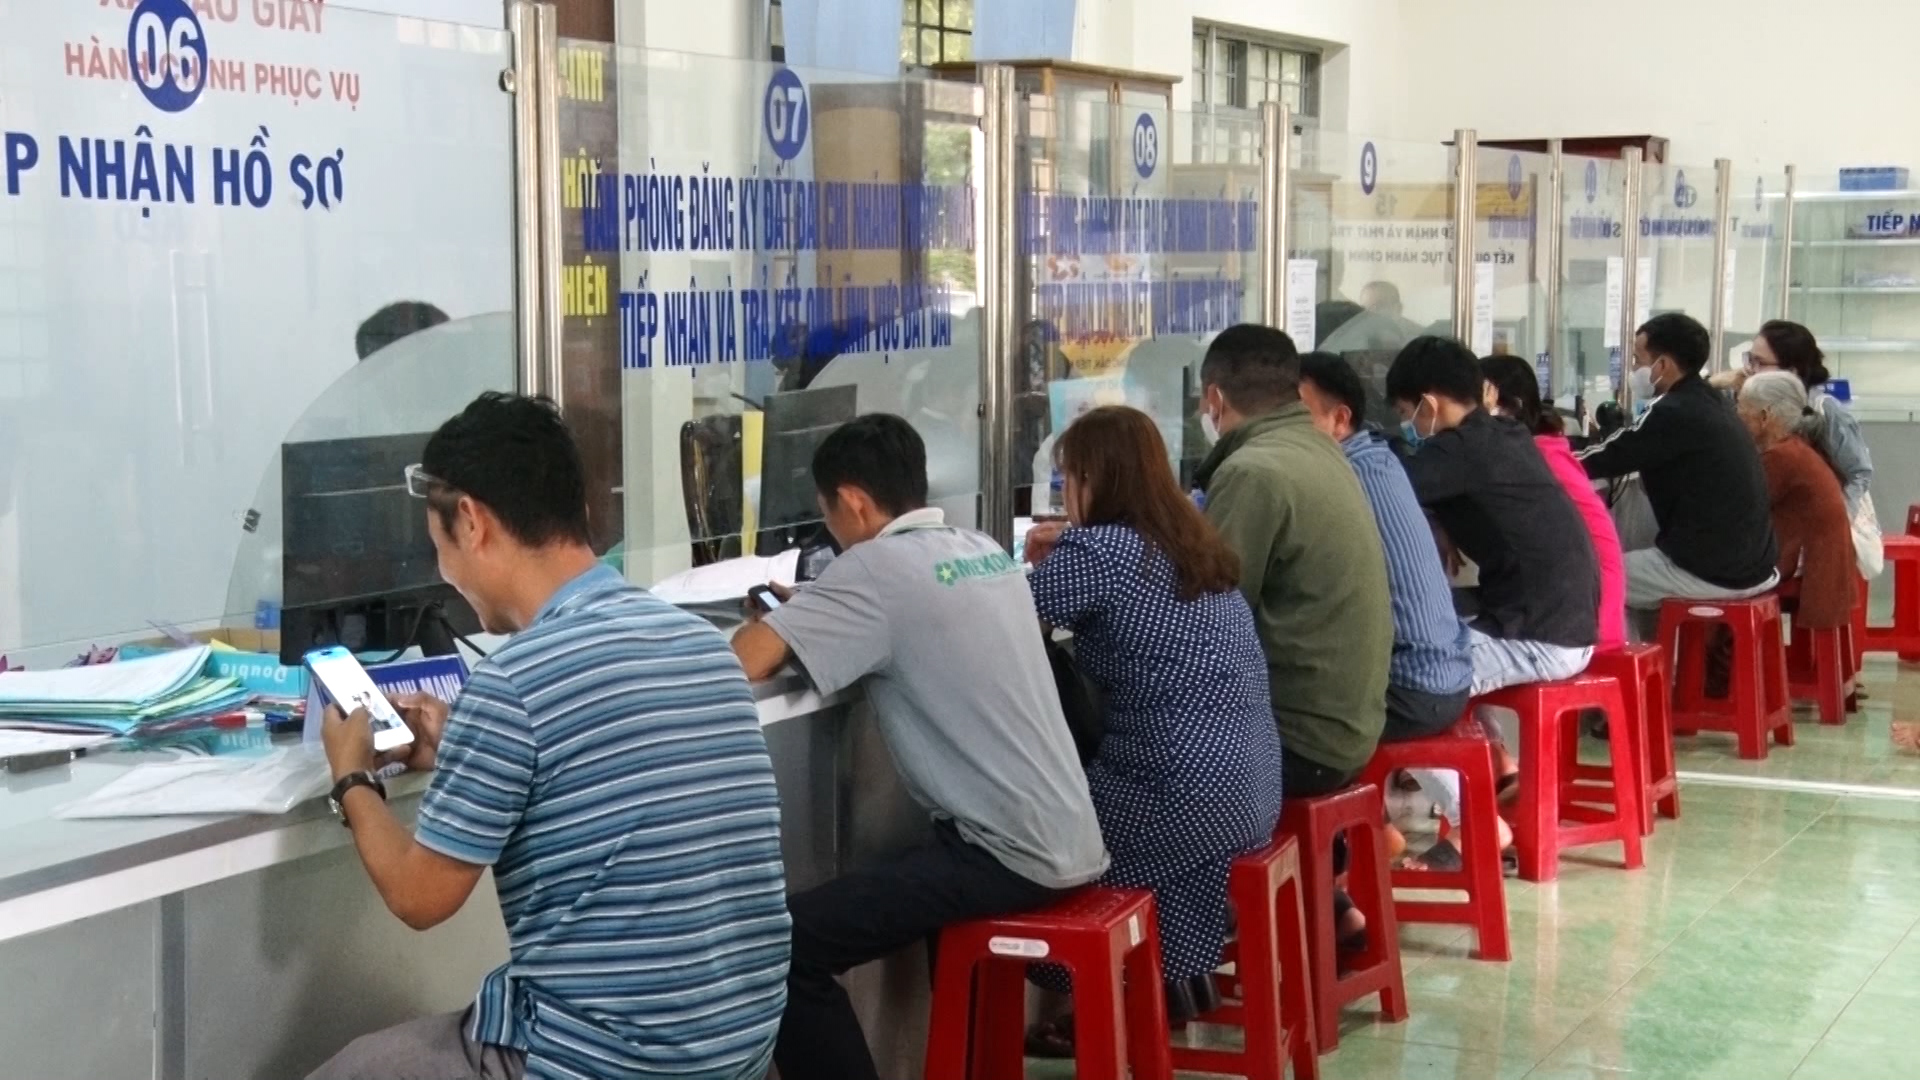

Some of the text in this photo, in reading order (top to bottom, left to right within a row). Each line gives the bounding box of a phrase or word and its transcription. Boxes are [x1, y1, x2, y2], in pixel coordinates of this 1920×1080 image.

[64, 35, 149, 82] HÀNH
[255, 63, 322, 106] PHỤC
[330, 71, 360, 111] VỤ
[136, 12, 199, 93] 06
[770, 87, 803, 144] 07
[1135, 124, 1156, 168] 08
[59, 125, 195, 218] NHẬN
[213, 125, 272, 208] HỒ
[624, 157, 684, 251] PHÒNG
[689, 161, 734, 251] ĐĂNG
[739, 165, 759, 250] KÝ
[1363, 149, 1373, 186] 9
[1866, 208, 1904, 231] TIẾP
[620, 269, 658, 369] TIẾP
[664, 276, 710, 378] NHẬN
[716, 276, 737, 362] VÀ
[741, 264, 770, 360] TRẢ
